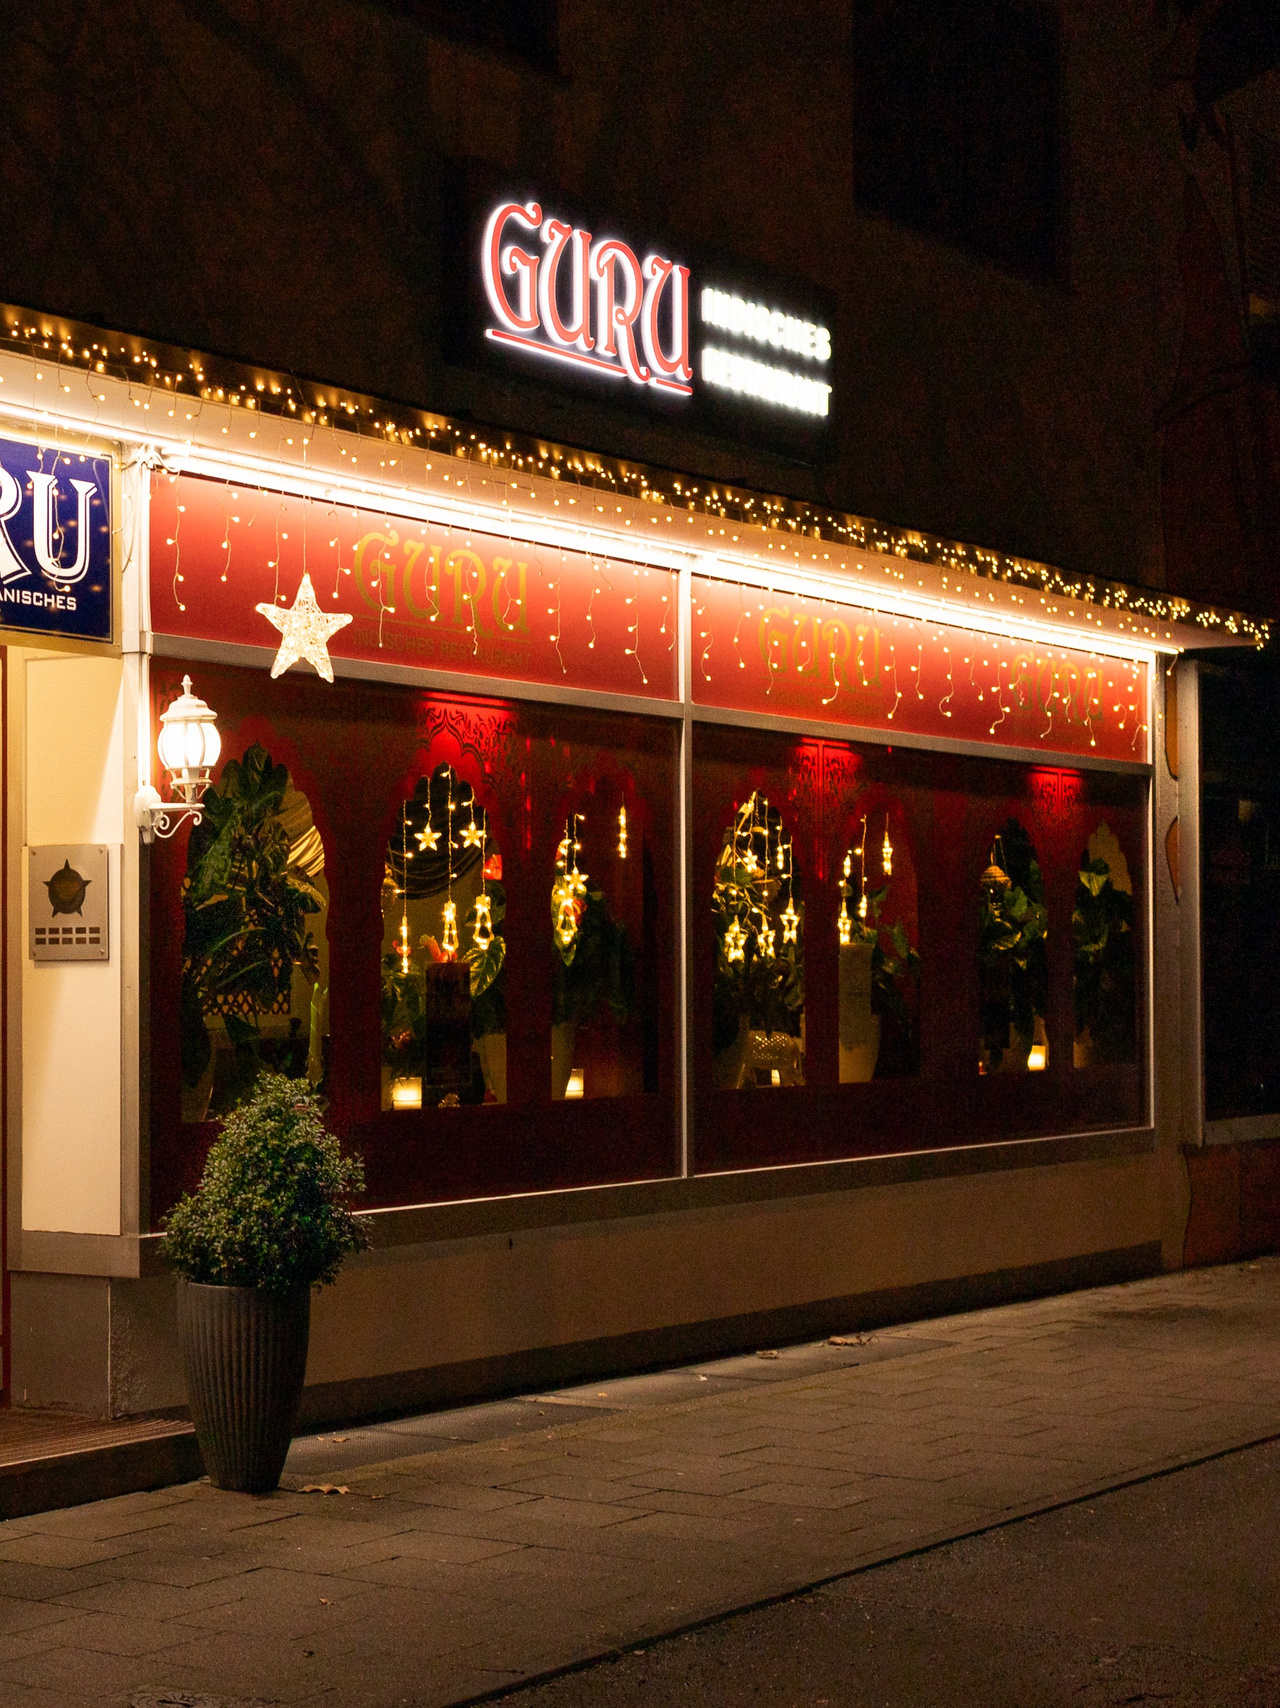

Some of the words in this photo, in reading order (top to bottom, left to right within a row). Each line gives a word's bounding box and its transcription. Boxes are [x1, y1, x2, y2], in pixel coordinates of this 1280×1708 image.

[483, 202, 693, 384] GURU
[353, 529, 530, 639] GURU
[758, 604, 883, 693] GURU
[1011, 651, 1104, 726] GURU
